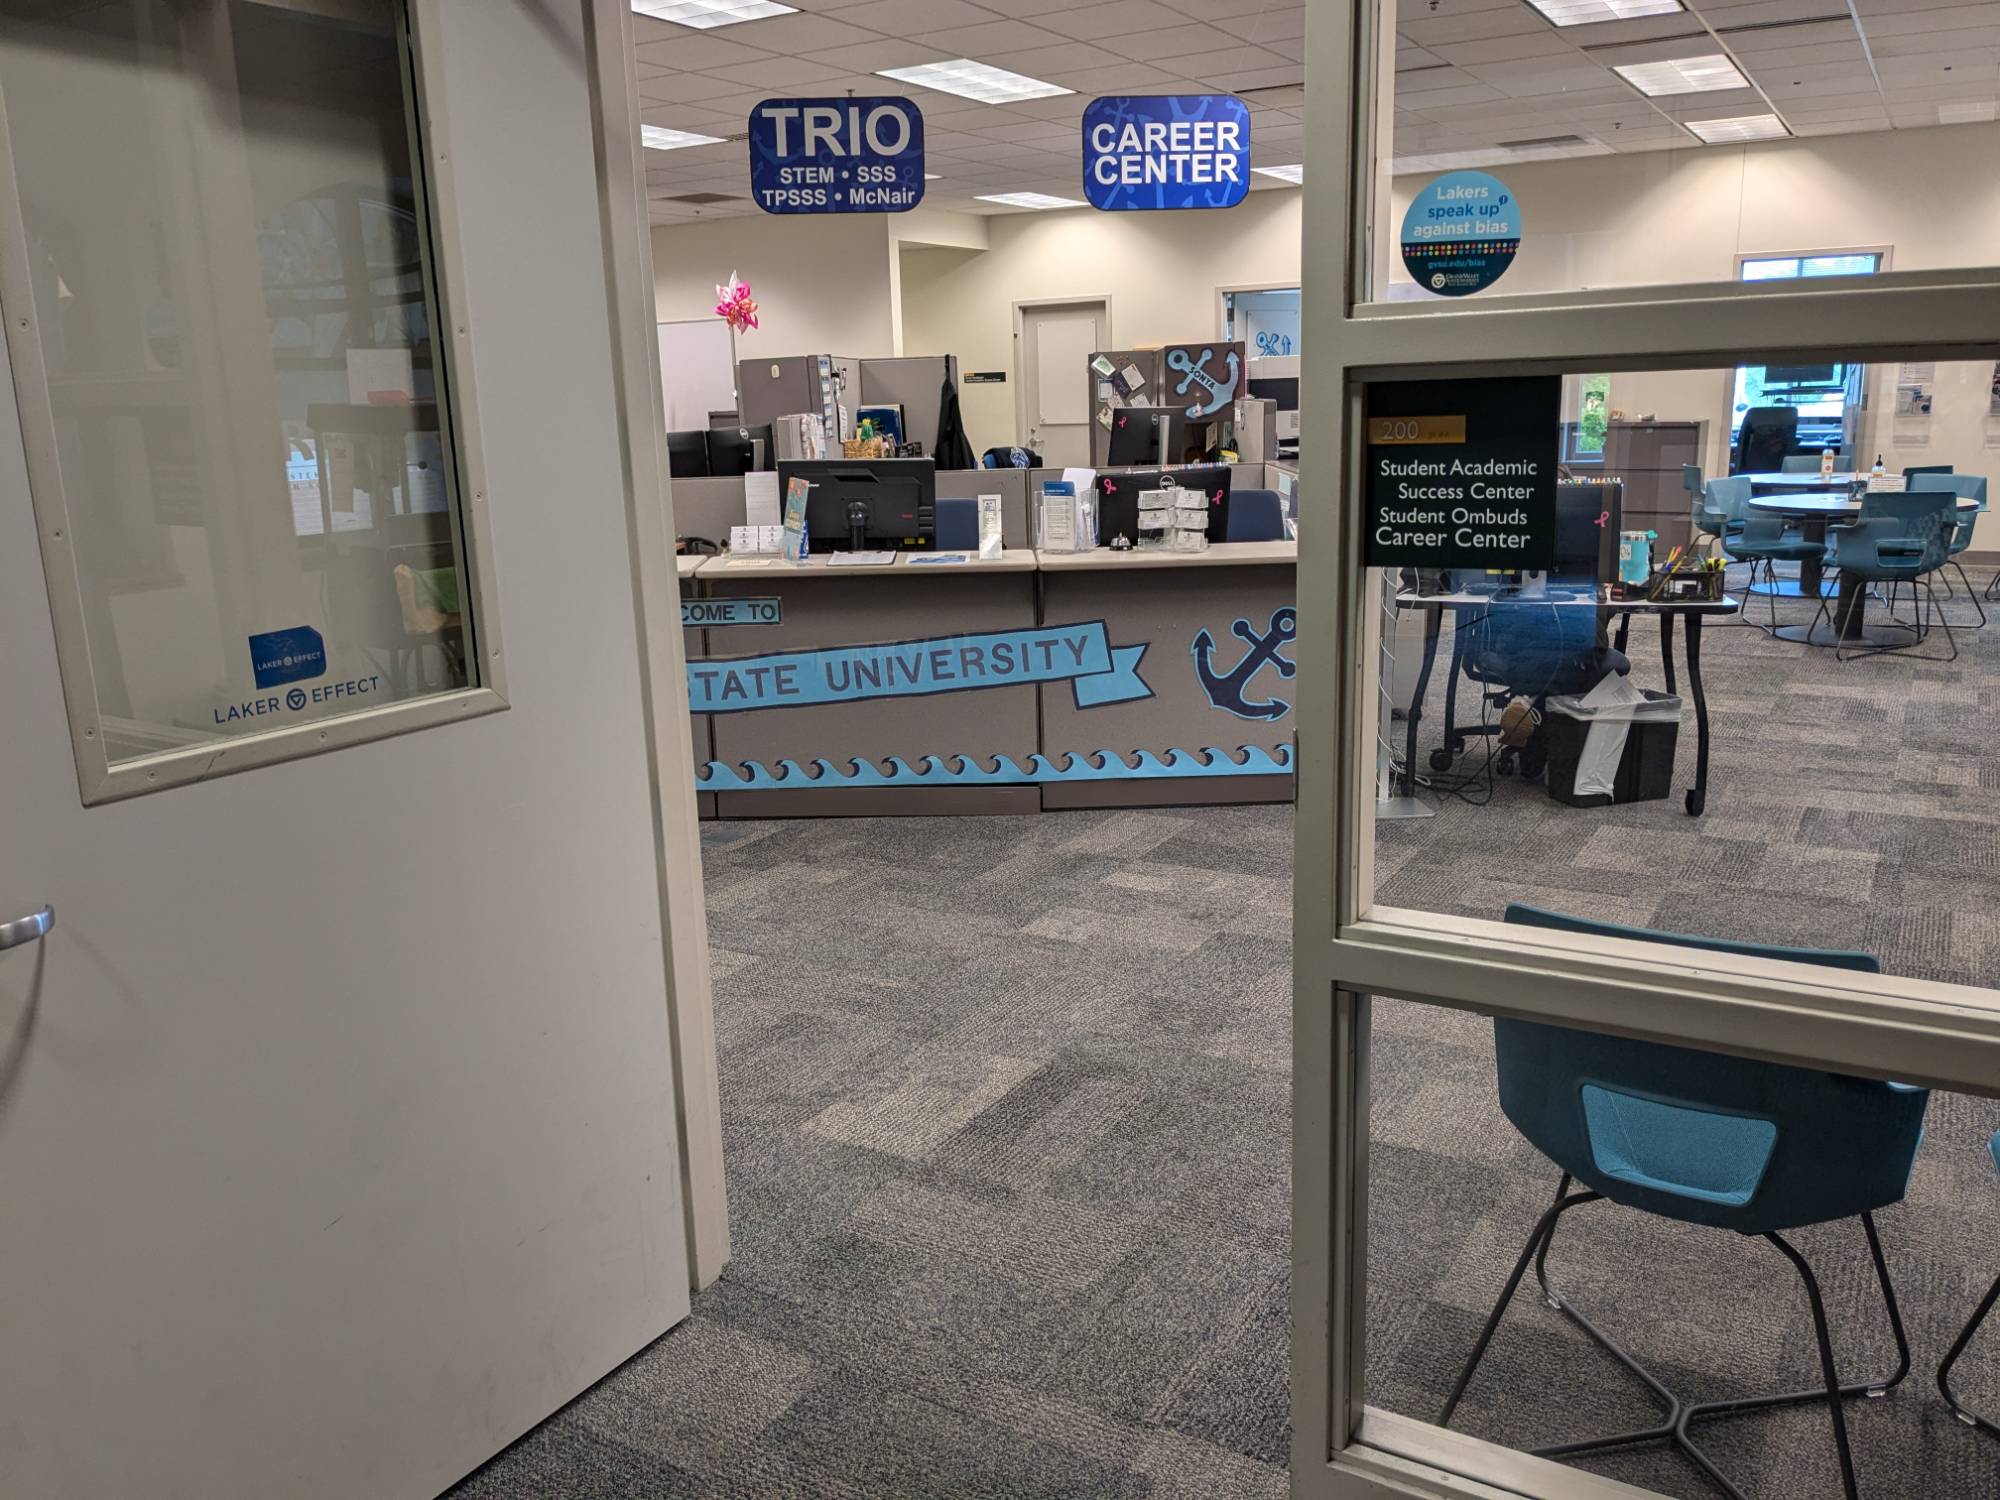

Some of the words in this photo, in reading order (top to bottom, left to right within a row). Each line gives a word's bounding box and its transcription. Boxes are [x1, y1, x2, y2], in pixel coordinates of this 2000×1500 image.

[762, 105, 911, 157] TRIO
[1092, 121, 1241, 153] CAREER
[780, 166, 834, 184] STEM
[857, 165, 896, 183] SSS
[1094, 153, 1239, 185] CENTER
[762, 188, 827, 206] TPSSS
[850, 187, 915, 204] McNair
[1436, 185, 1489, 200] Lakers
[1428, 203, 1474, 220] speak
[1479, 204, 1500, 217] up
[1413, 222, 1470, 238] against
[1475, 220, 1508, 234] bias
[1189, 366, 1215, 390] SONYA
[1383, 421, 1419, 439] 200
[1380, 459, 1446, 476] Student
[1450, 458, 1537, 476] Academic
[1399, 482, 1464, 500] Success
[1470, 482, 1535, 499] Center
[1380, 507, 1446, 524] Student
[1451, 507, 1528, 525] Ombuds
[1376, 527, 1447, 547] Career
[1455, 528, 1531, 549] Center
[748, 603, 776, 620] TO
[257, 658, 283, 671] LAKER
[687, 664, 800, 702] TATE
[825, 634, 1088, 692] UNIVERSITY
[214, 696, 281, 724] LAKER
[311, 675, 379, 703] EFFECT
